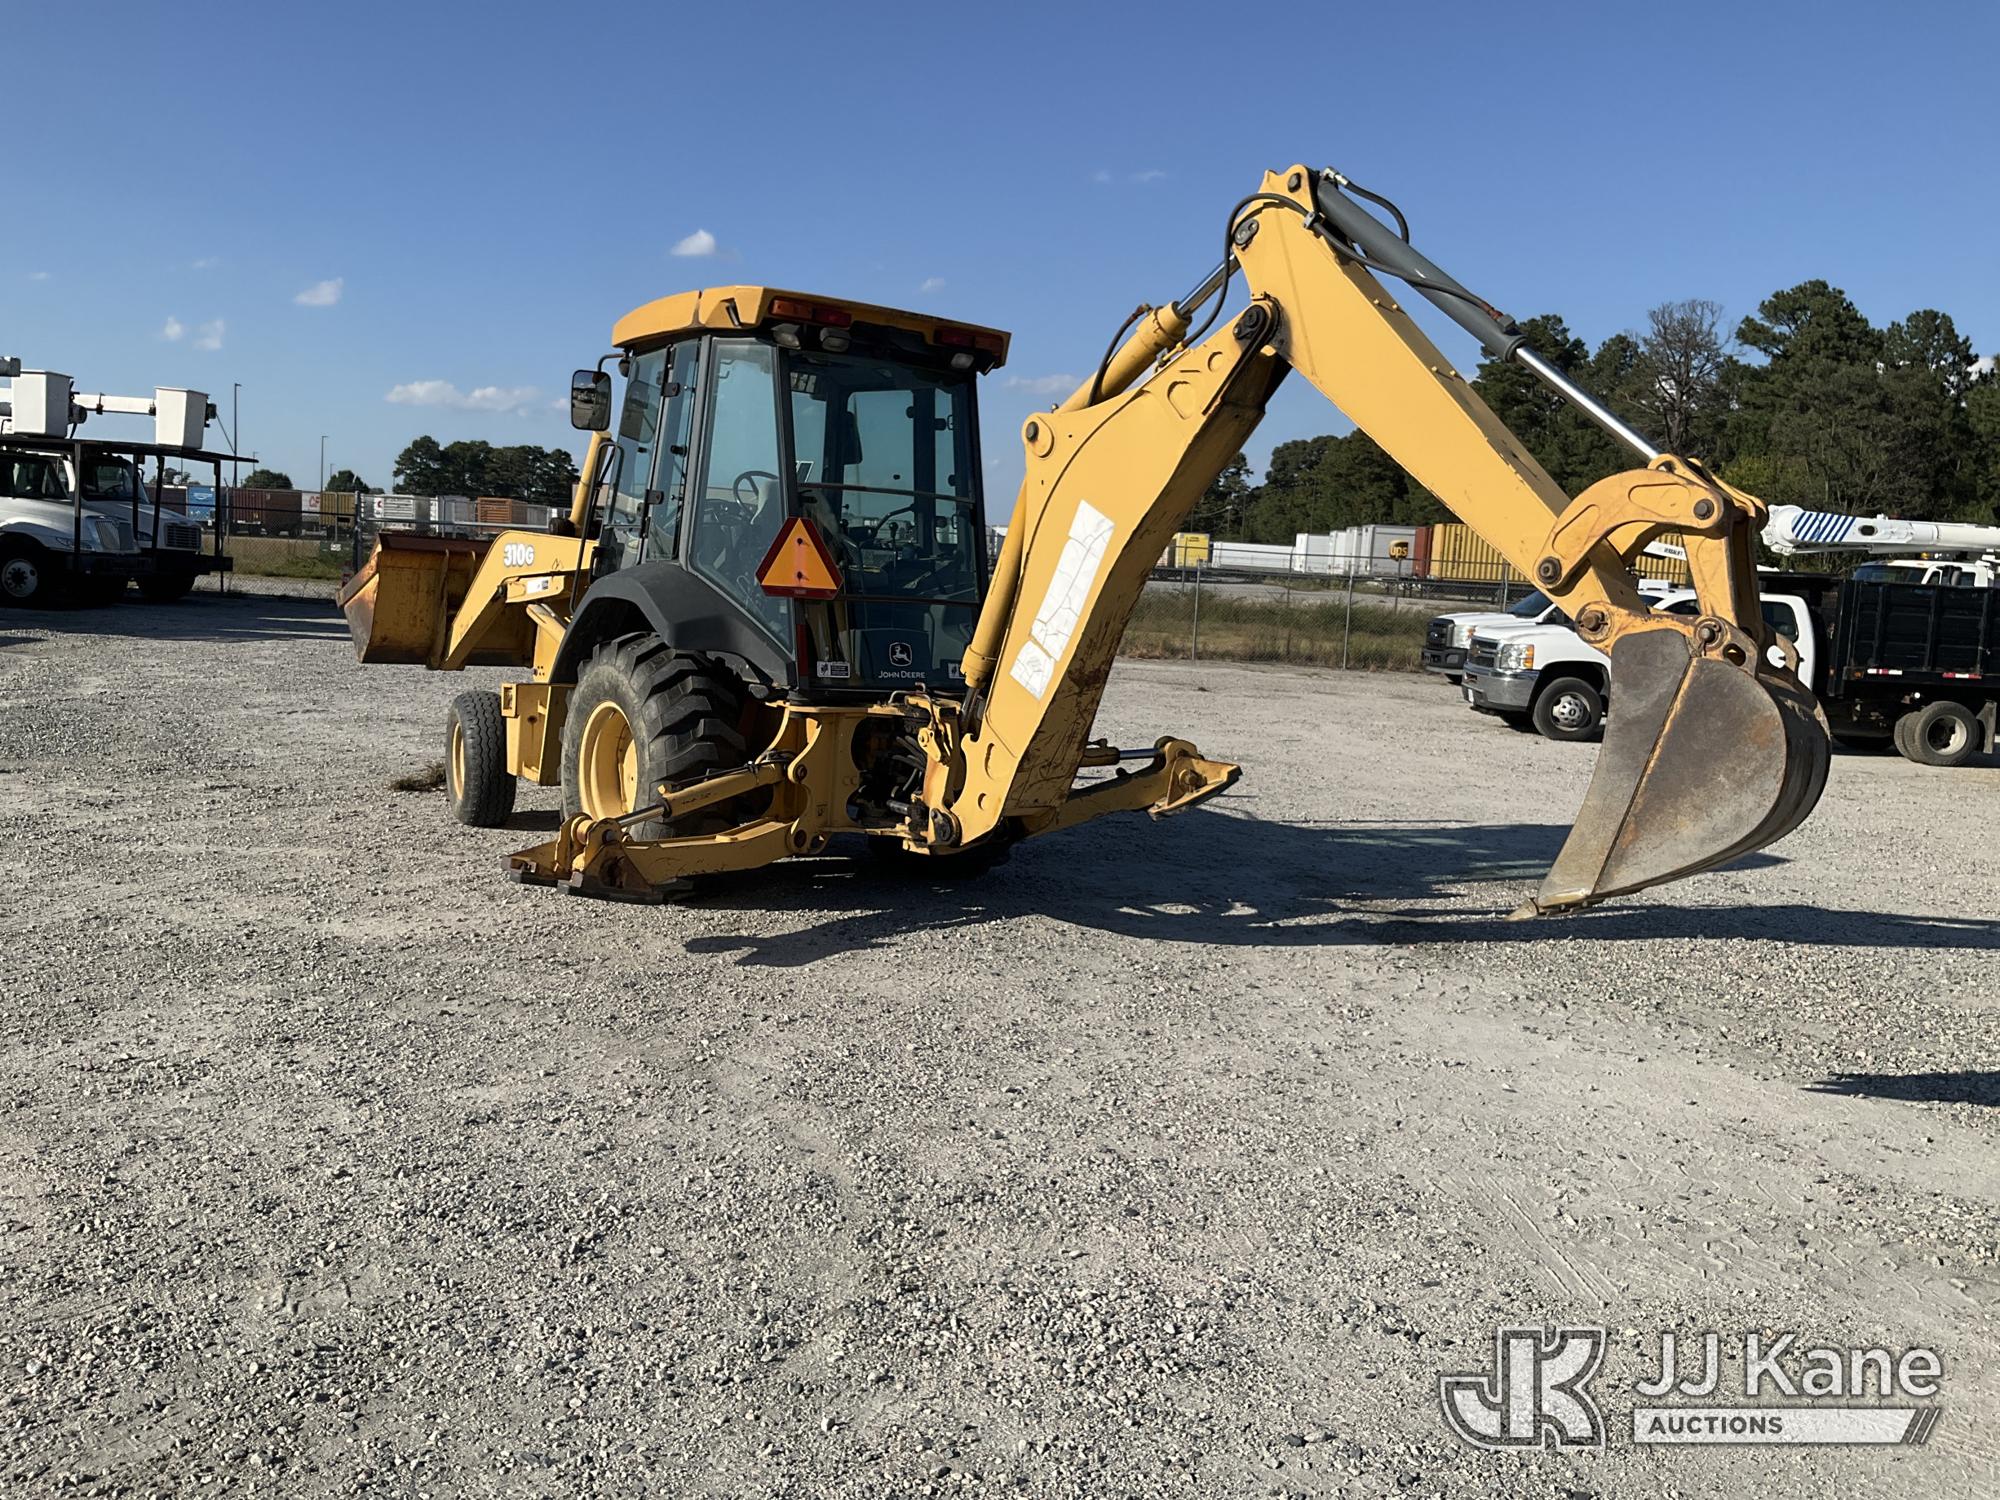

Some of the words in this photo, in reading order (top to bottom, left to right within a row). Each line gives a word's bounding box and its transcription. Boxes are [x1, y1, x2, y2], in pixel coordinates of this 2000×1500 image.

[504, 543, 534, 567] 310G
[1390, 546, 1407, 558] ups
[878, 670, 900, 679] JOHN
[901, 670, 926, 679] DEERE
